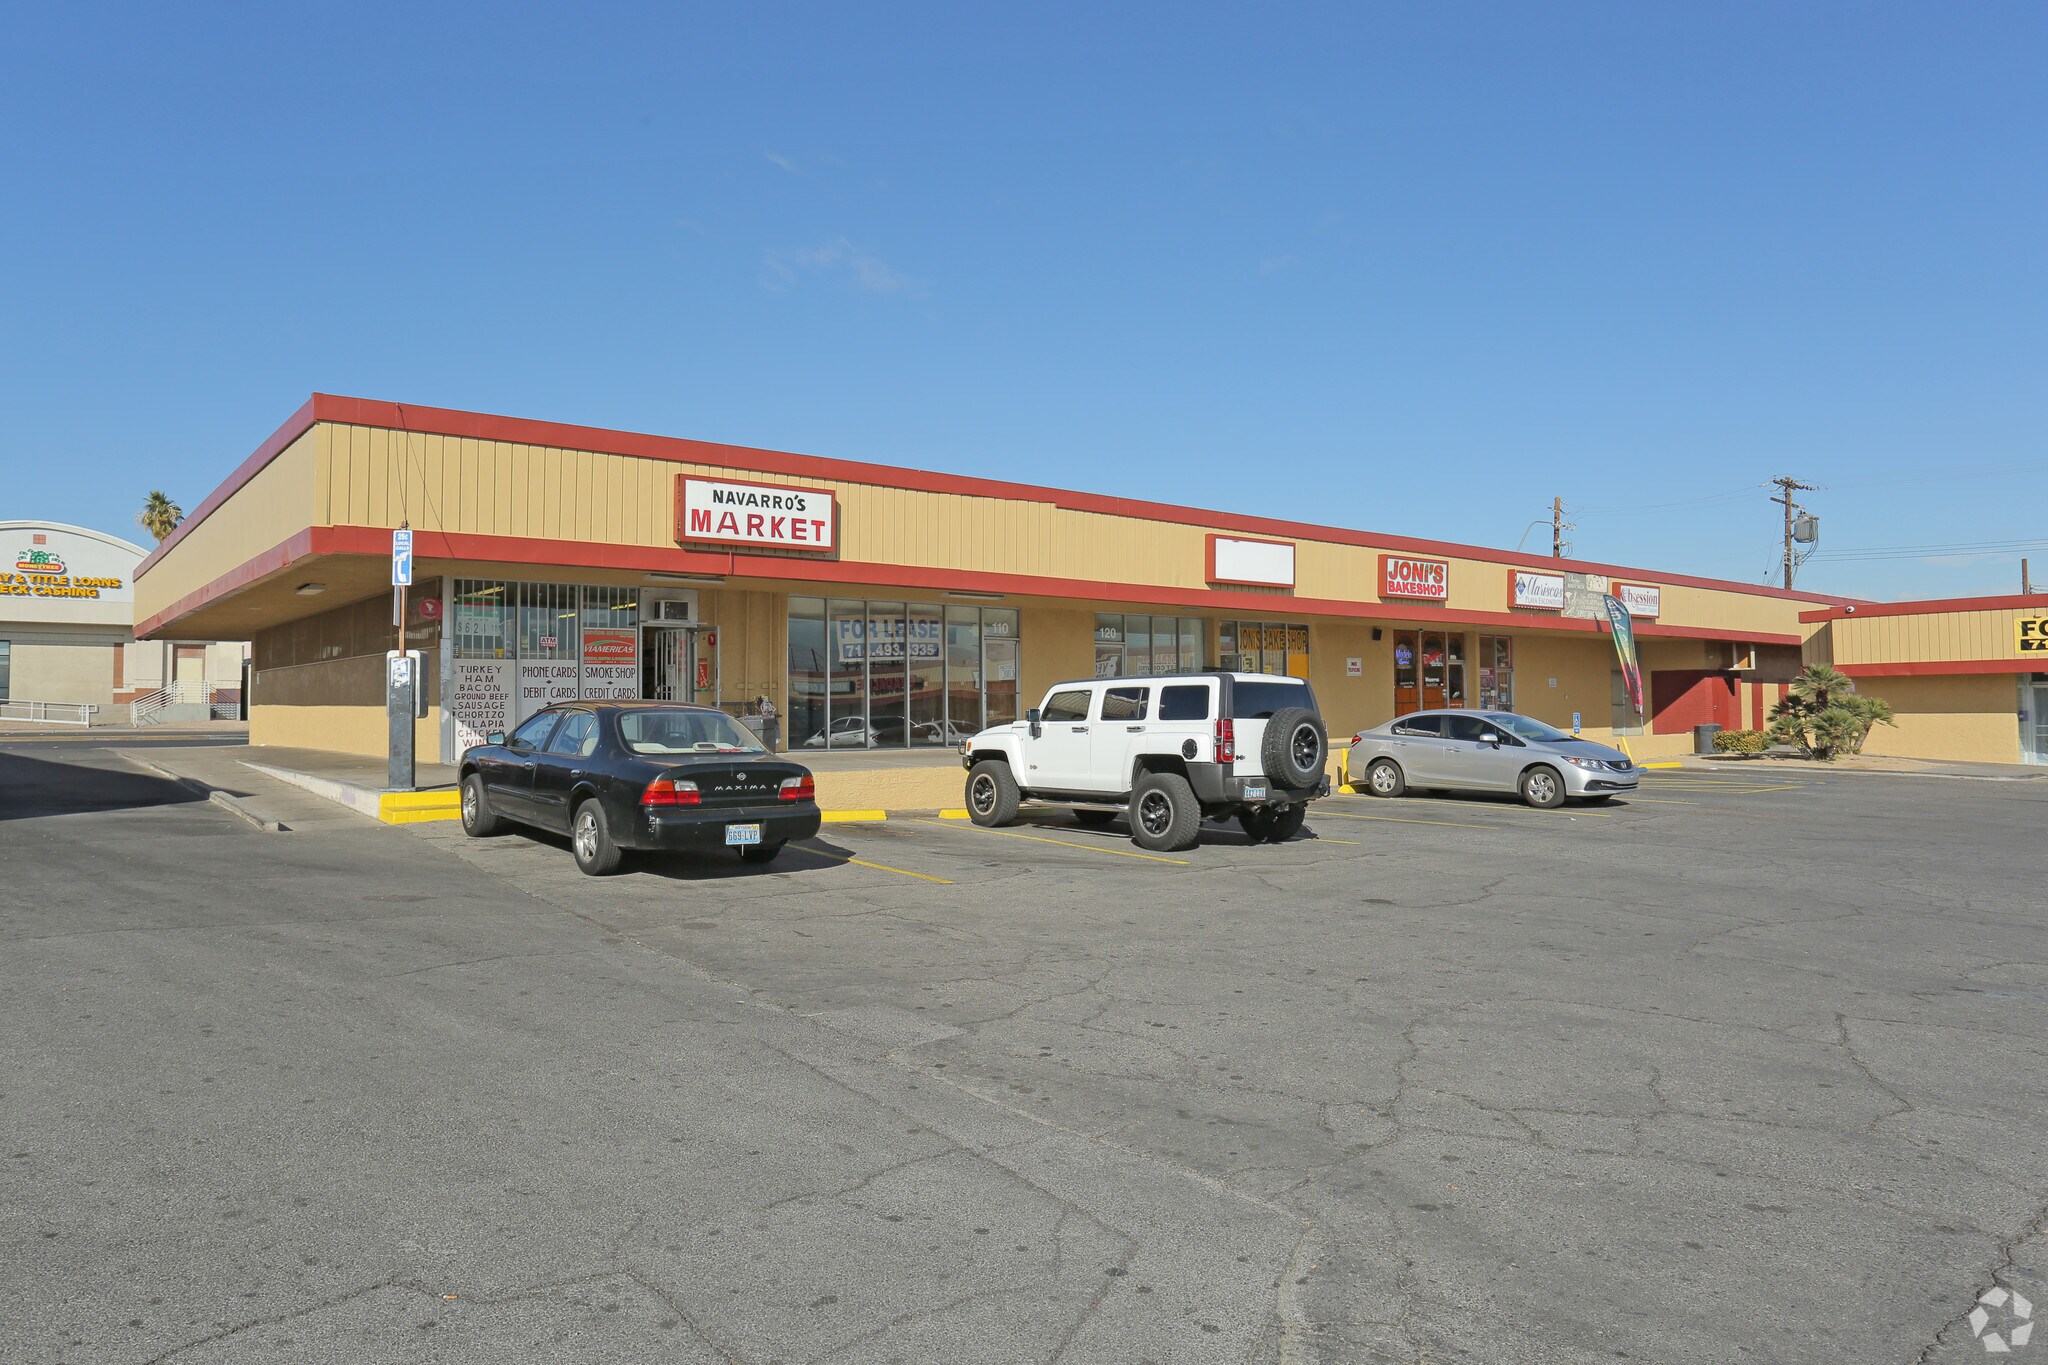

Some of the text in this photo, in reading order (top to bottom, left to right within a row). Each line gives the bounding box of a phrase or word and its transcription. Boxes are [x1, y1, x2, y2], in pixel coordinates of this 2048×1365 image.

[712, 489, 806, 512] NAVARRO'S
[690, 508, 826, 542] MARKET
[18, 562, 60, 570] MONEYTREE
[1388, 560, 1444, 584] JONI'S
[15, 574, 25, 583] &
[28, 574, 68, 585] TITLE
[73, 576, 120, 587] LOANS
[32, 586, 97, 597] CASHING
[1388, 580, 1444, 596] BAKESHOP
[841, 619, 940, 639] FOR LEASE
[992, 622, 1009, 634] 110
[1100, 627, 1116, 639] 120
[584, 645, 634, 653] VIAMERICAS
[522, 667, 577, 678] PHONE CARDS
[585, 667, 636, 679] SMOKE SHOP
[465, 675, 494, 683] HAM
[459, 684, 501, 692] BACON
[523, 687, 576, 698] DEBIT CARDS
[584, 688, 636, 699] CREDIT CARDS
[458, 702, 505, 710] SAUSAGE
[457, 711, 505, 719] CHORIZO
[460, 720, 505, 728] TILAPIA
